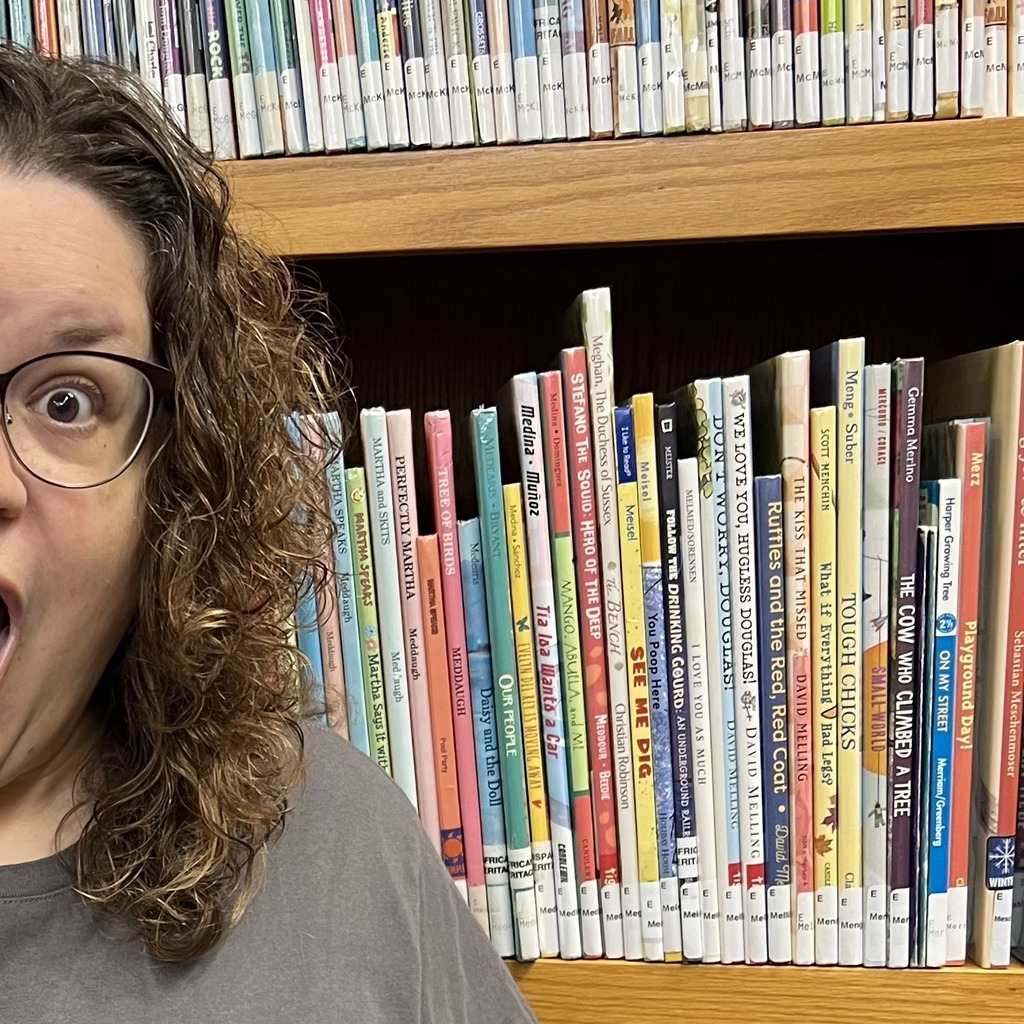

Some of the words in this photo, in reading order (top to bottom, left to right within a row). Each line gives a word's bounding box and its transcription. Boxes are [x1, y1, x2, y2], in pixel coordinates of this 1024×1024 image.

[207, 30, 223, 79] ROCK
[592, 336, 604, 387] Meghan,
[570, 373, 586, 435] STEFANO
[596, 389, 607, 413] The
[842, 370, 858, 410] Meng
[521, 405, 535, 455] Medina
[734, 413, 745, 438] WE
[906, 387, 919, 435] Gemma
[576, 441, 587, 464] THE
[596, 416, 610, 467] Duchess
[846, 424, 858, 464] Suber
[905, 439, 918, 482] Merino
[600, 469, 611, 481] of
[735, 444, 747, 486] LOVE
[970, 452, 984, 486] Merz
[395, 455, 410, 539] PERFECTLY
[438, 468, 450, 509] TREE
[526, 471, 539, 516] Muñoz
[577, 469, 592, 518] SQUID:
[601, 484, 613, 526] Sussex
[442, 512, 452, 530] OF
[626, 505, 637, 541] Meisel
[736, 492, 748, 528] YOU,
[443, 533, 455, 576] BIRDS
[581, 520, 595, 554] HERO
[768, 502, 782, 570] Ruffles
[354, 512, 368, 562] MARTHA
[361, 564, 373, 607] SPEAKS
[402, 542, 415, 600] MARTHA
[584, 559, 596, 574] OF
[737, 533, 751, 603] HUGLESS
[584, 578, 600, 603] THE
[770, 576, 783, 613] and
[820, 563, 832, 596] What
[900, 574, 915, 599] THE
[586, 606, 602, 639] DEEP
[821, 604, 831, 617] if
[842, 592, 856, 667] TOUGH
[898, 604, 916, 644] COW
[741, 609, 756, 684] DOUGLAS!
[770, 619, 784, 650] the
[630, 646, 646, 687] SEE
[769, 655, 785, 699] Red,
[820, 625, 833, 704] Everything
[897, 653, 913, 686] WHO
[939, 650, 951, 669] ON
[960, 620, 977, 711] Playground
[1011, 629, 1024, 687] Sebastian
[498, 674, 513, 707] OUR
[538, 665, 556, 713] Wants
[938, 674, 949, 691] MY
[481, 688, 493, 725] Daisy
[544, 718, 555, 728] a
[634, 698, 649, 728] ME
[772, 705, 786, 742] Red
[841, 674, 855, 751] CHICKS
[893, 690, 913, 759] CLIMBED
[937, 696, 949, 732] STREET
[483, 729, 495, 753] and
[503, 711, 517, 757] PEOPLE
[546, 732, 560, 758] Car
[821, 723, 833, 747] Had
[958, 716, 974, 750] Day!
[1005, 687, 1021, 777] Meschenmoser
[486, 757, 497, 778] the
[636, 741, 651, 780] DIG
[773, 747, 787, 793] Coat
[820, 752, 833, 785] Legs?
[895, 766, 909, 777] A
[488, 781, 501, 806] Doll
[893, 781, 911, 817] TREE
